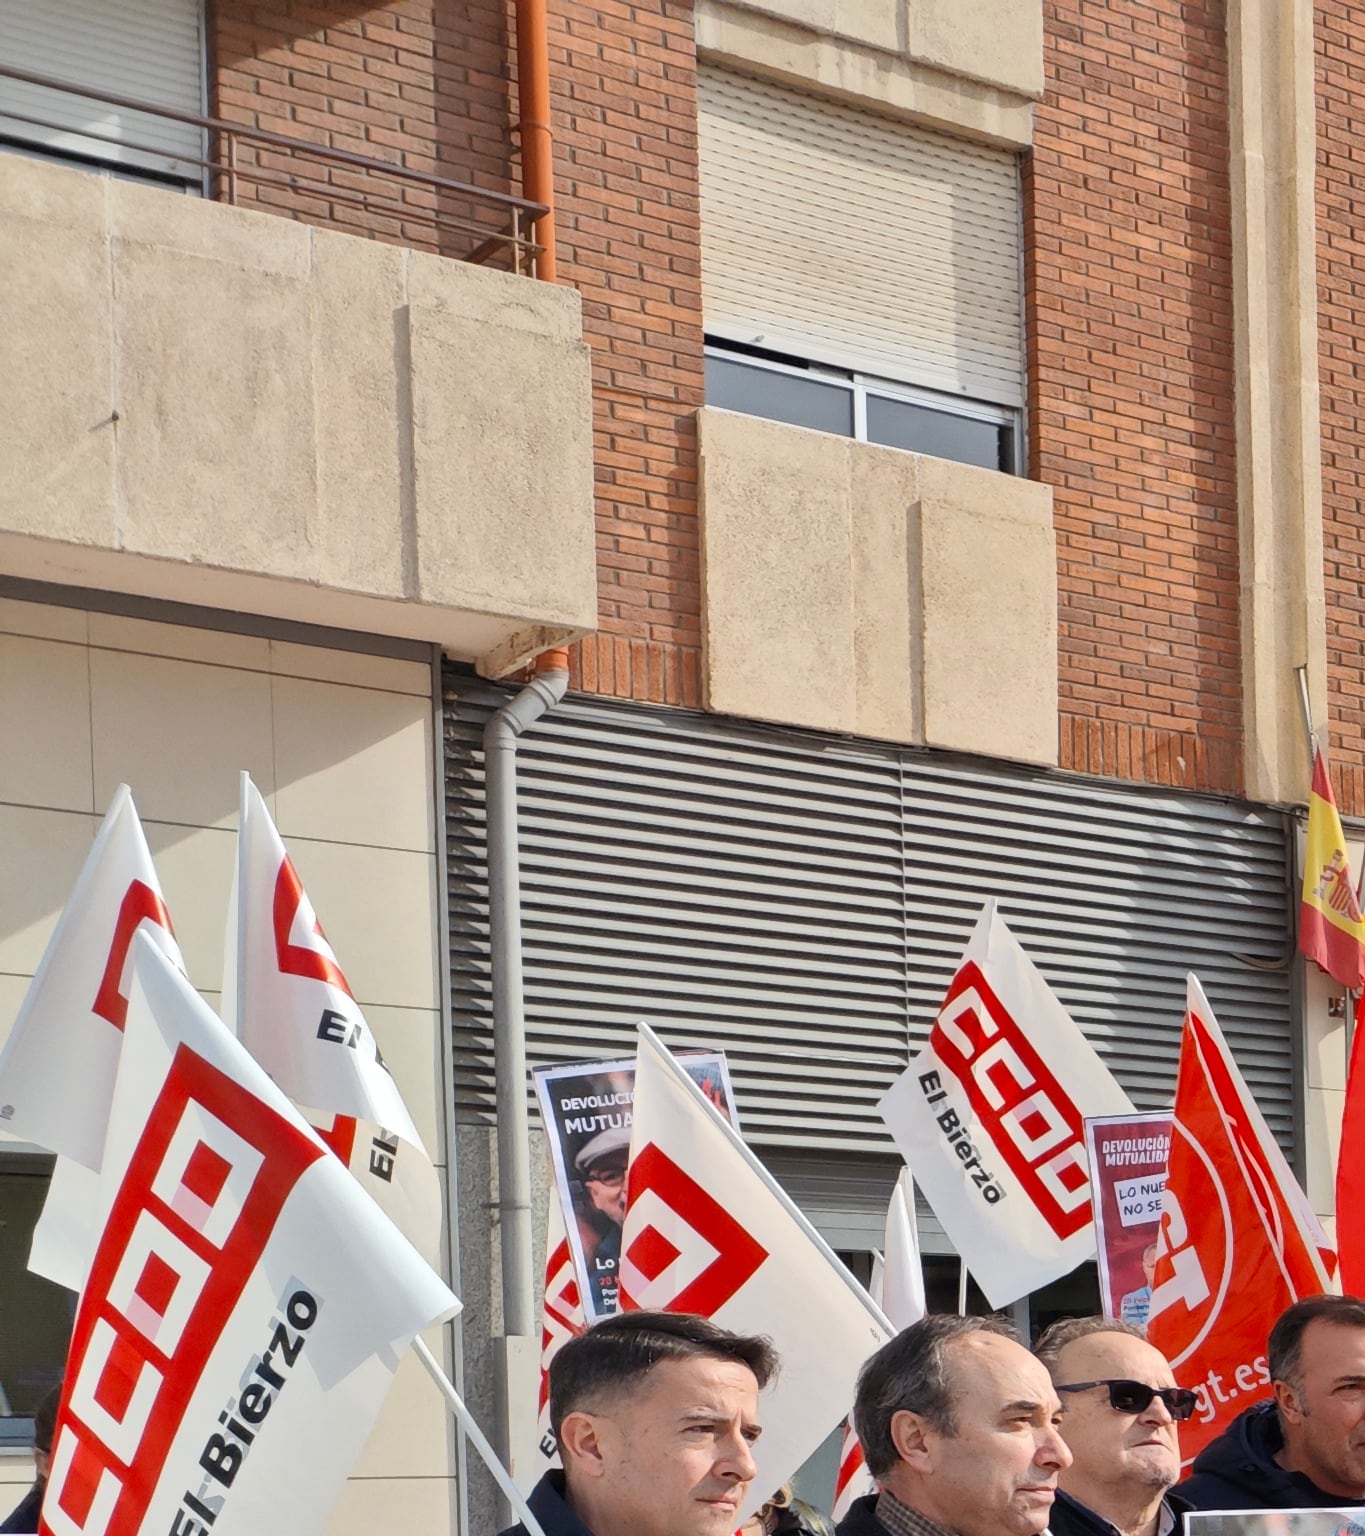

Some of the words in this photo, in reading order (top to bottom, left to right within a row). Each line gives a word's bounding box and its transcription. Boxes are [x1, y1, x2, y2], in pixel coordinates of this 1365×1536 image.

[918, 1070, 948, 1104] El
[936, 1107, 1001, 1204] Bierzo
[1119, 1186, 1136, 1200] LO
[1123, 1203, 1143, 1216] NO
[1148, 1199, 1162, 1211] SE
[199, 1291, 319, 1488] Bierzo
